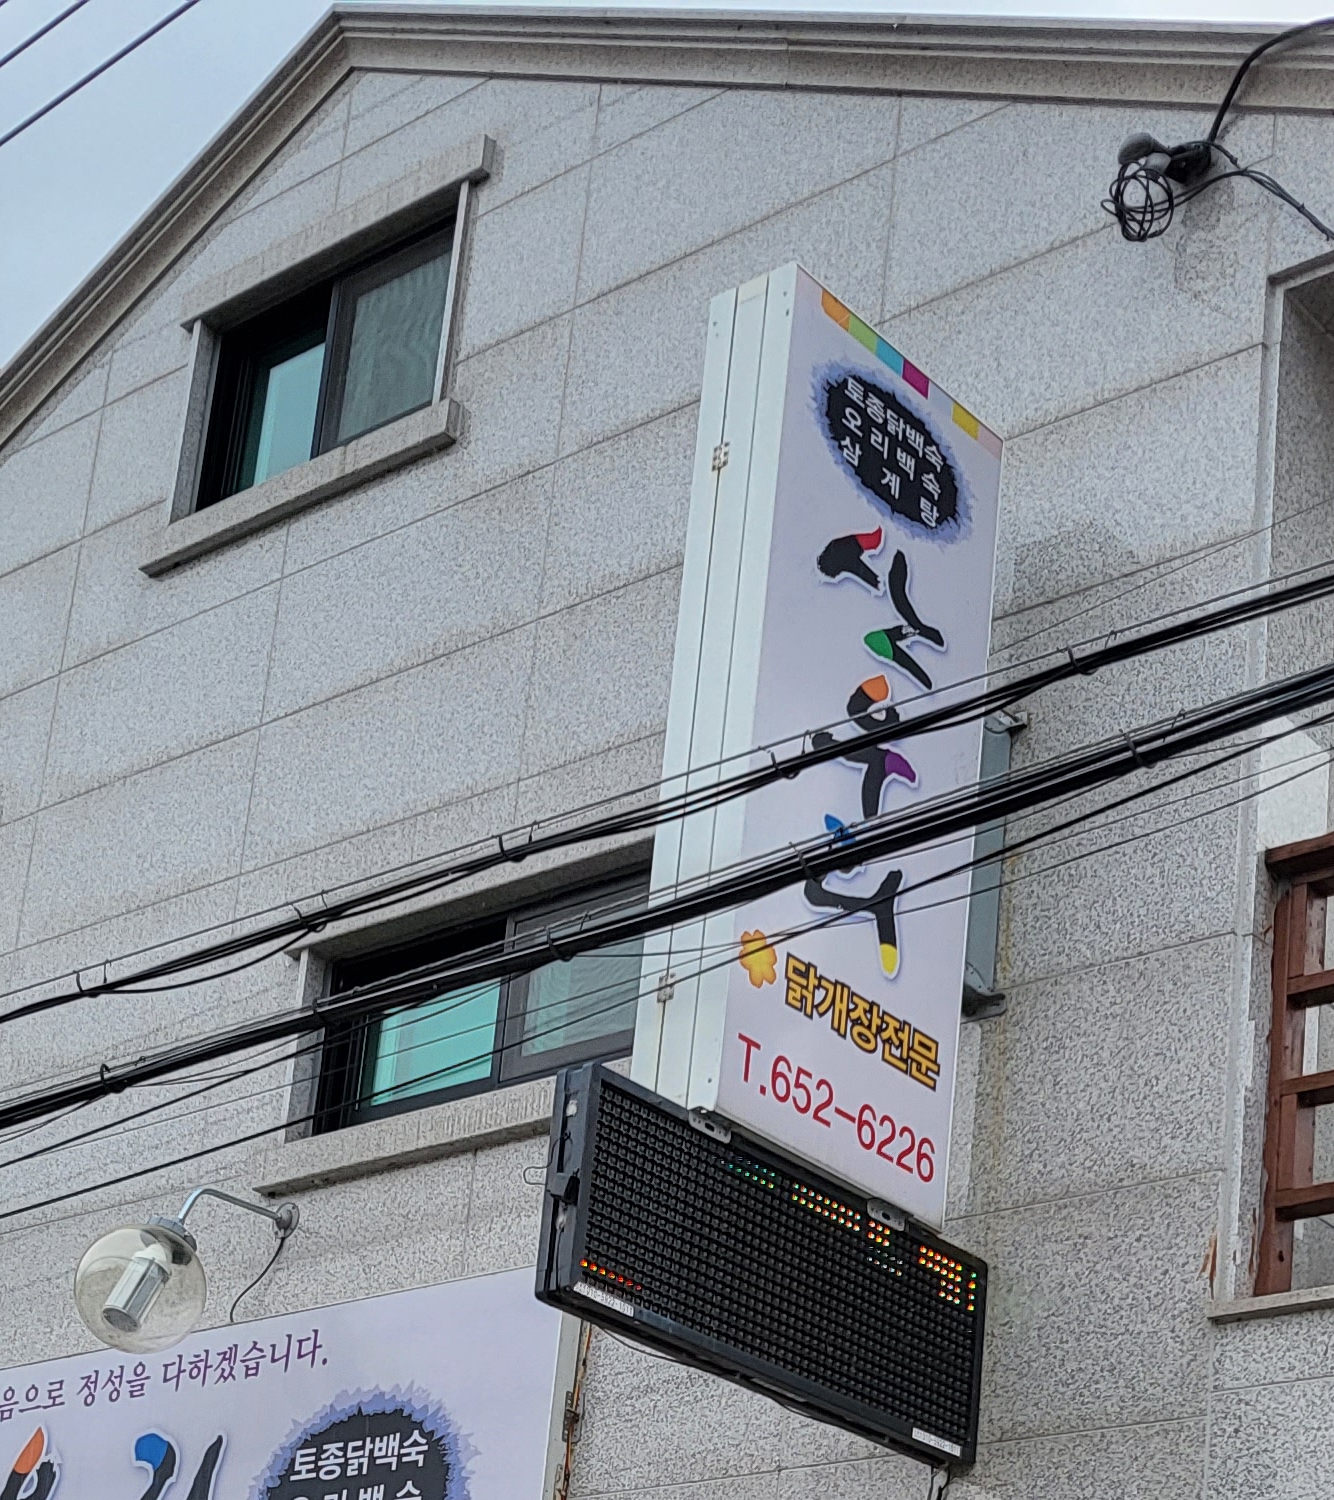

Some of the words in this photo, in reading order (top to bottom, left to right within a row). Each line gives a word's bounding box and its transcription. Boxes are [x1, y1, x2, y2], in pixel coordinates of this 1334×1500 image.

[842, 407, 941, 501] 오리백숙
[844, 377, 944, 473] 토종닭백숙
[840, 436, 940, 527] 삼계탕
[785, 952, 940, 1092] 닭개장전문
[738, 1032, 936, 1183] T.652-6226
[76, 1360, 152, 1408] 정성을
[162, 1329, 329, 1391] 다하겠습니다.
[289, 1430, 429, 1482] 토종닭백숙
